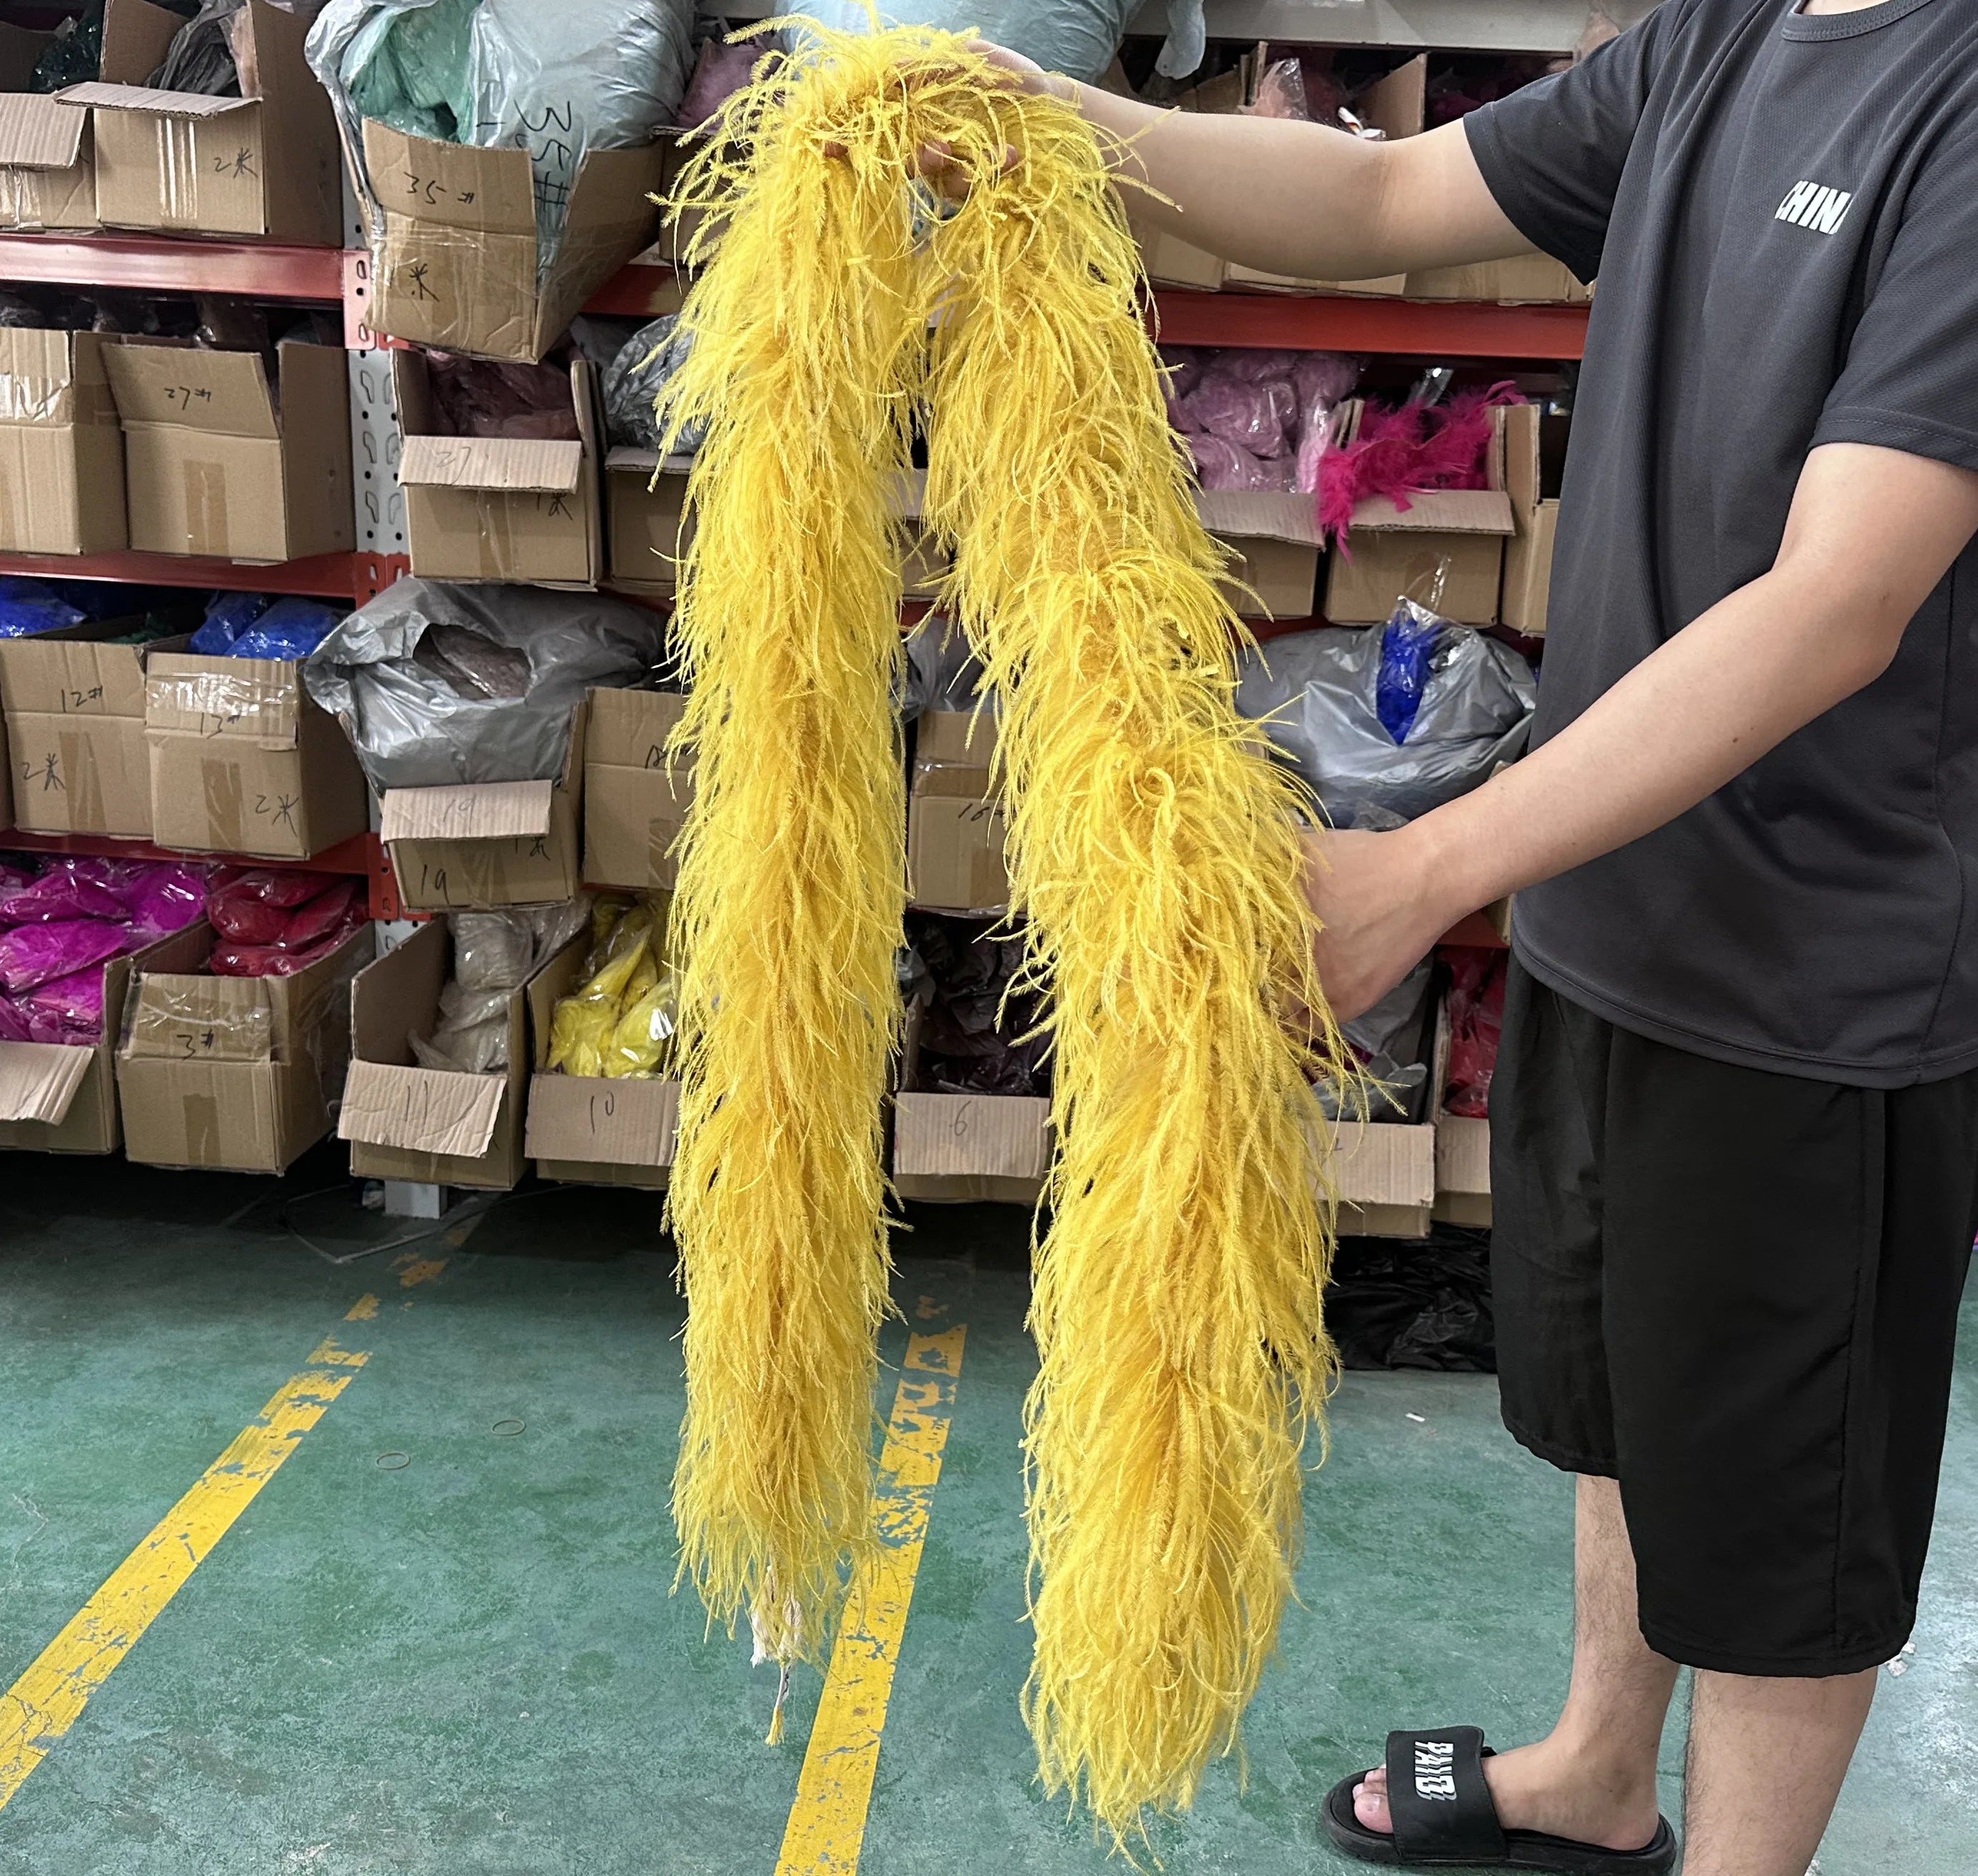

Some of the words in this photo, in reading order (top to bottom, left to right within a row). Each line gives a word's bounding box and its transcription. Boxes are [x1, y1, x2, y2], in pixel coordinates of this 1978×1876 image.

[213, 147, 259, 180] 2米
[62, 685, 104, 714] 12#
[21, 752, 67, 792] 2米
[255, 794, 300, 838] 2米
[442, 794, 476, 835] 19
[421, 864, 452, 906] 19
[176, 1028, 215, 1061] 3#
[404, 1079, 428, 1134] 11
[590, 1090, 615, 1134] 10
[954, 1100, 972, 1137] 6
[1415, 1741, 1458, 1801] PAID
